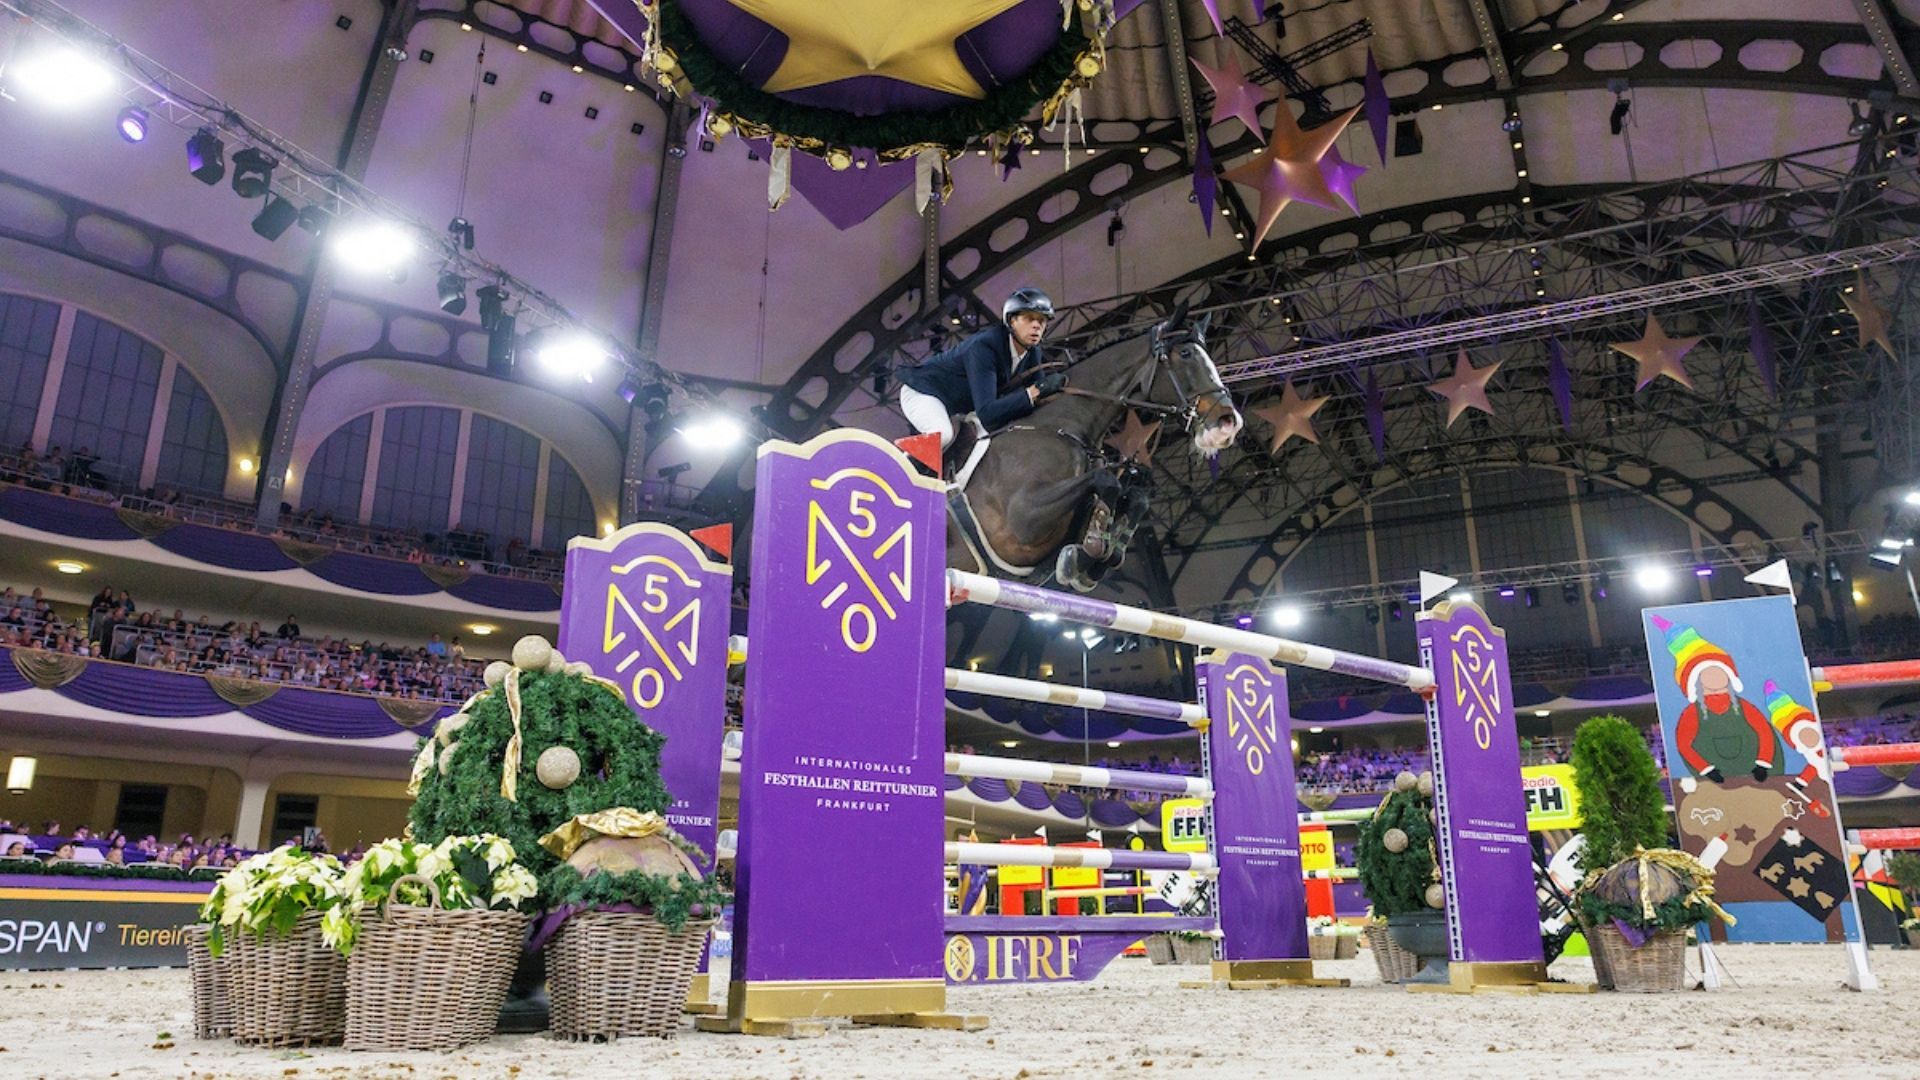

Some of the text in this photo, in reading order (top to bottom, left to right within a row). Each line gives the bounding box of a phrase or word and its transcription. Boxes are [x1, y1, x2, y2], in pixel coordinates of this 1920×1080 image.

[795, 756, 911, 775] INTERNATIONALES
[764, 772, 938, 797] FESTHALLEN REITTURNIER
[816, 798, 890, 812] FRANKFURT
[985, 935, 1083, 980] IFRF
